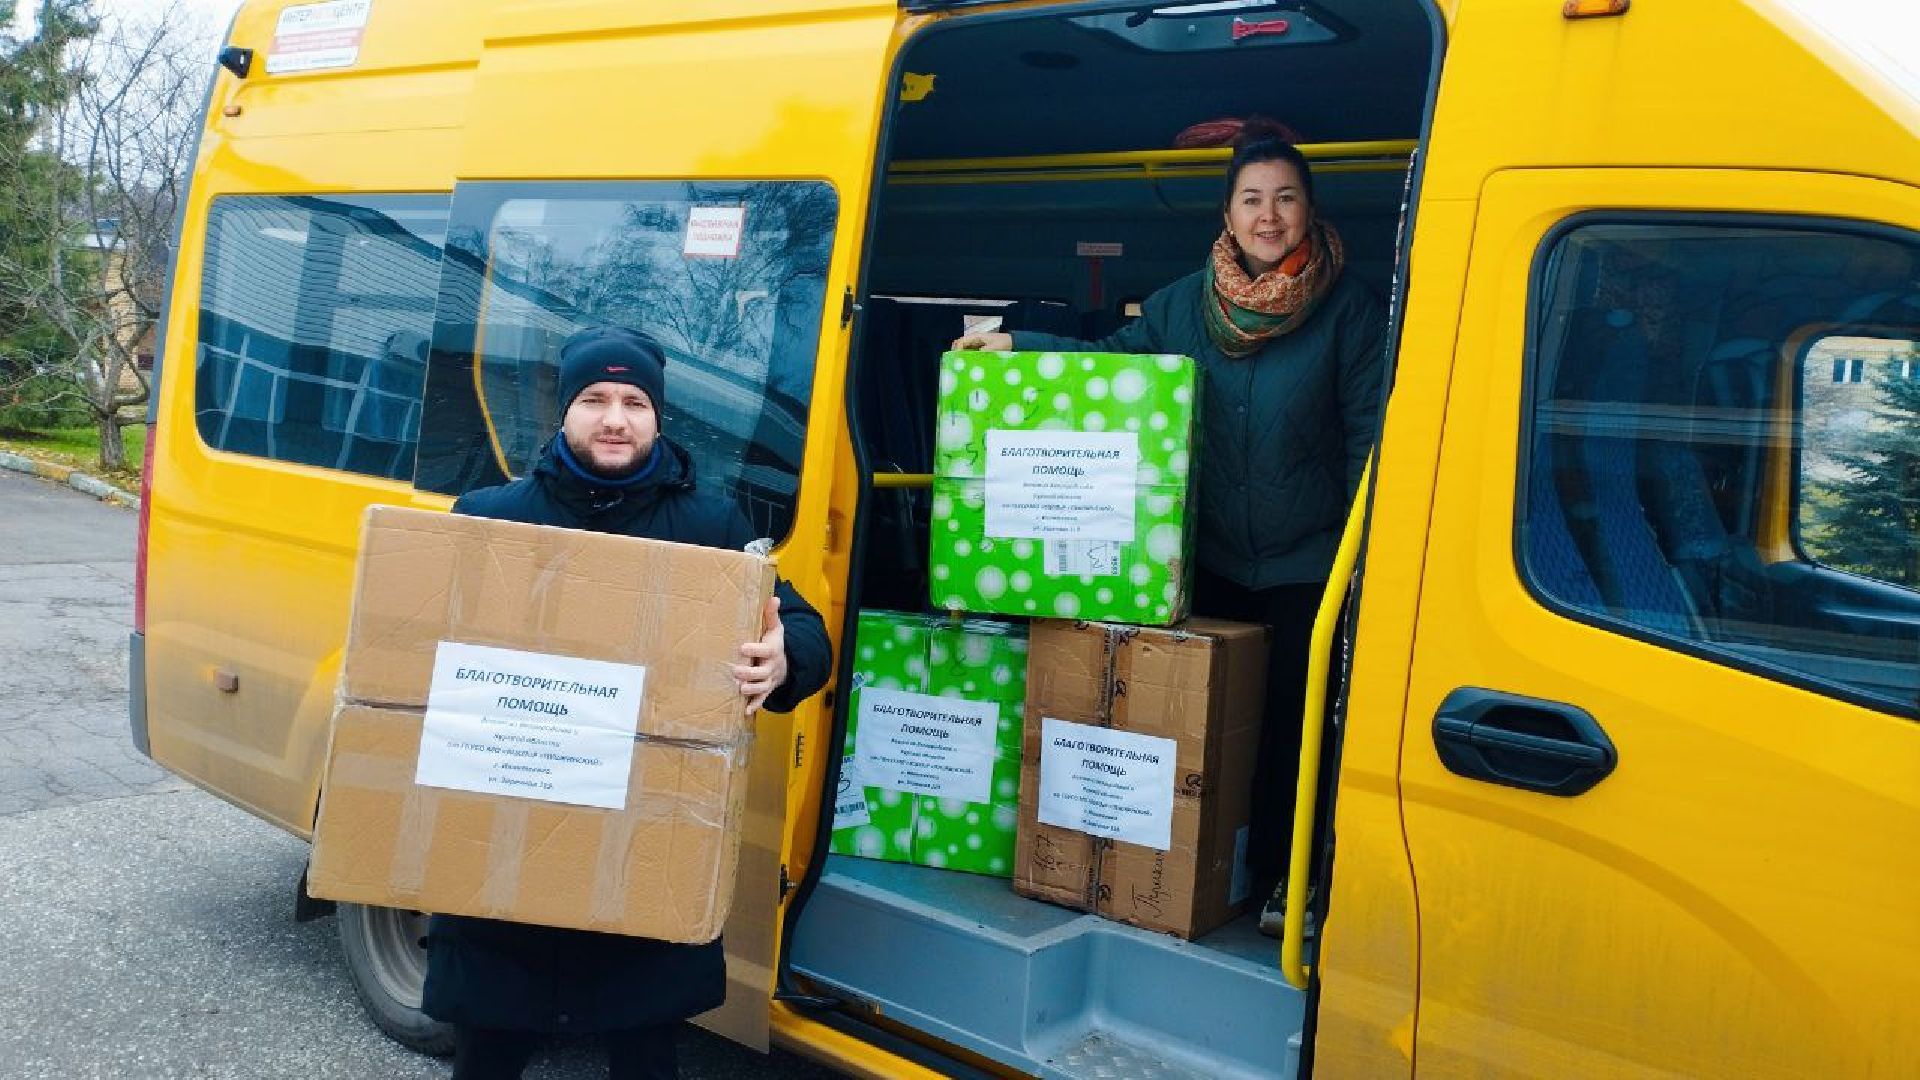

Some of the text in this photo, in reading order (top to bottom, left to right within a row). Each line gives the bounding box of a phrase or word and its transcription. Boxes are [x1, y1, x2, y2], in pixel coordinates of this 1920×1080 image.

[1000, 447, 1120, 459] БЛАГОТВОРИТЕЛЬНАЯ
[1032, 465, 1085, 477] ПОМОЩЬ
[456, 668, 618, 699] БЛАГОТВОРИТЕЛЬНАЯ
[496, 696, 569, 717] ПОМОЩЬ
[873, 704, 982, 727] БЛАГОТВОРИТЕЛЬНАЯ
[900, 723, 950, 739] ПОМОЩЬ
[1053, 737, 1160, 765] БЛАГОТВОРИТЕЛЬНАЯ
[1081, 758, 1127, 777] ПОМОЩЬ
